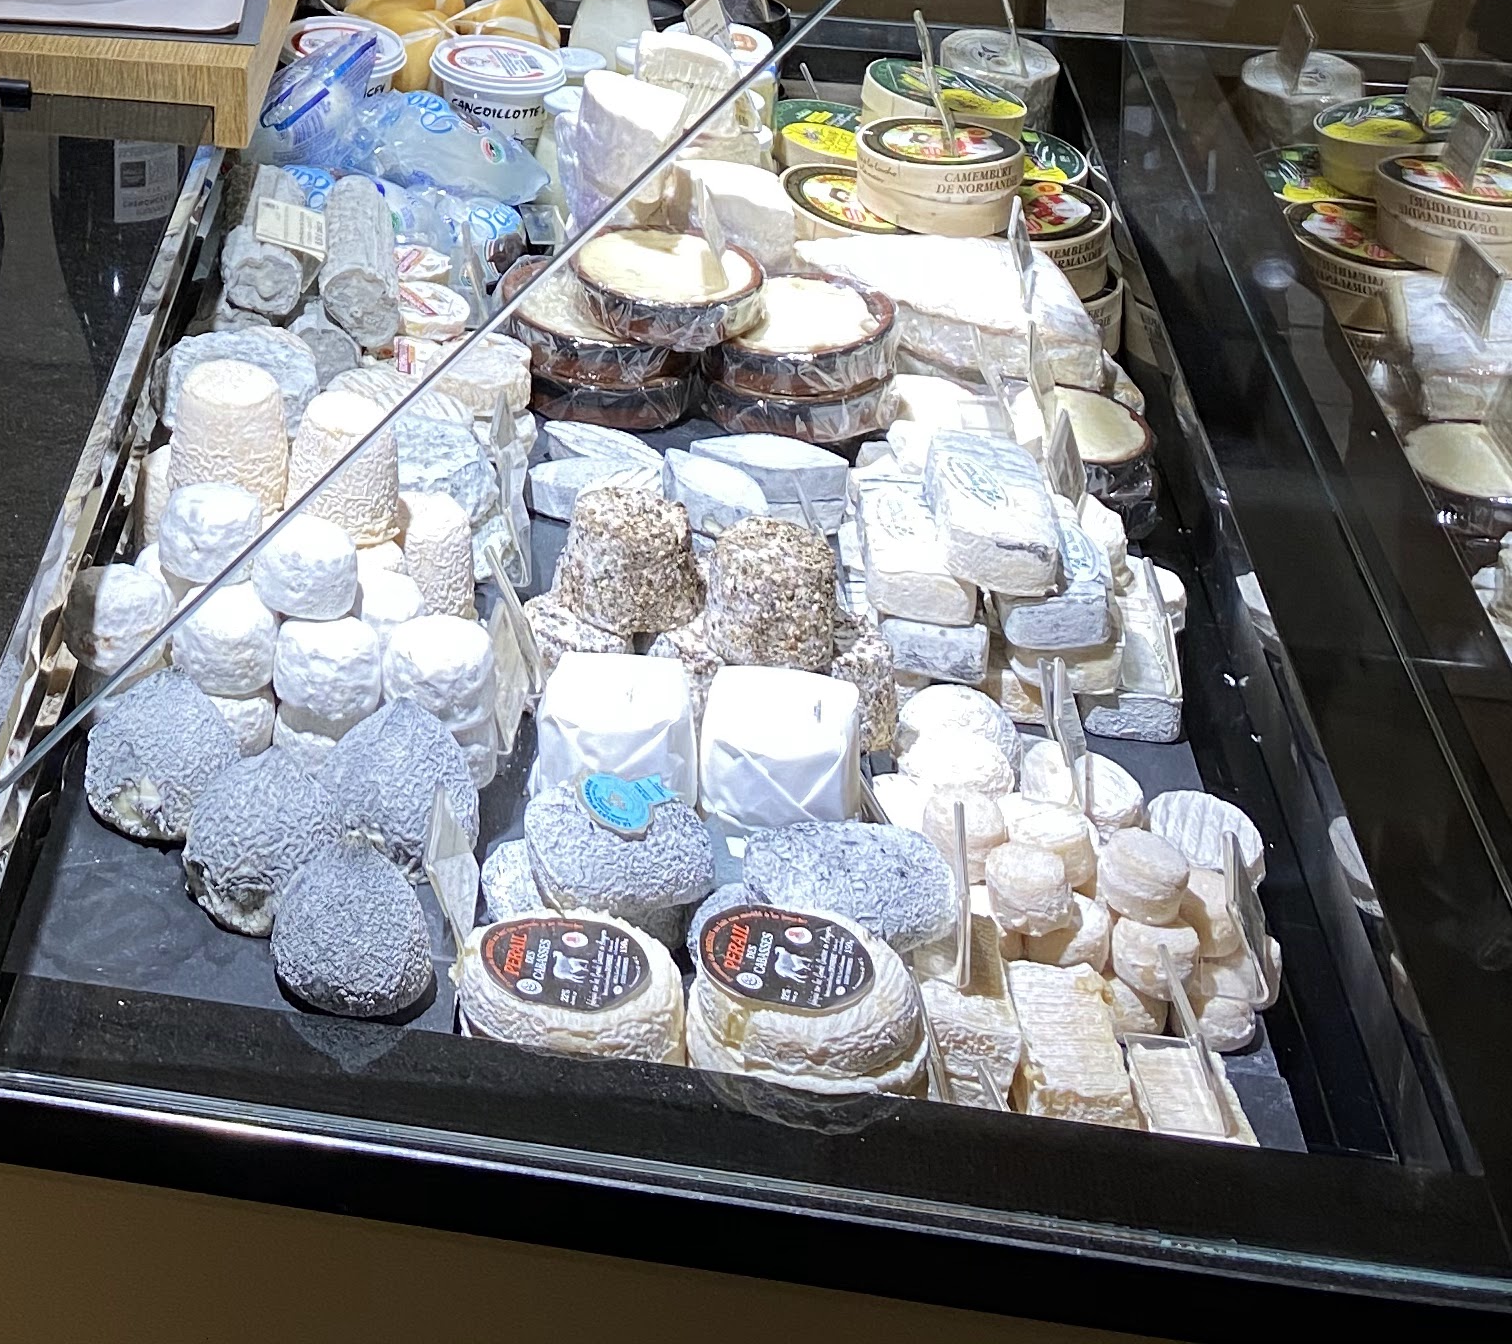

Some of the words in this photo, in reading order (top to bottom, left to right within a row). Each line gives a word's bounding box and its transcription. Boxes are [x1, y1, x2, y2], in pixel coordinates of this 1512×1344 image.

[451, 97, 541, 120] CANCOILLOTTE
[936, 183, 955, 195] DE
[956, 175, 1018, 195] NORMANDIE
[944, 166, 1014, 183] CAMEMBERT
[504, 932, 528, 977] PERAIL
[723, 923, 750, 971] PERAIL
